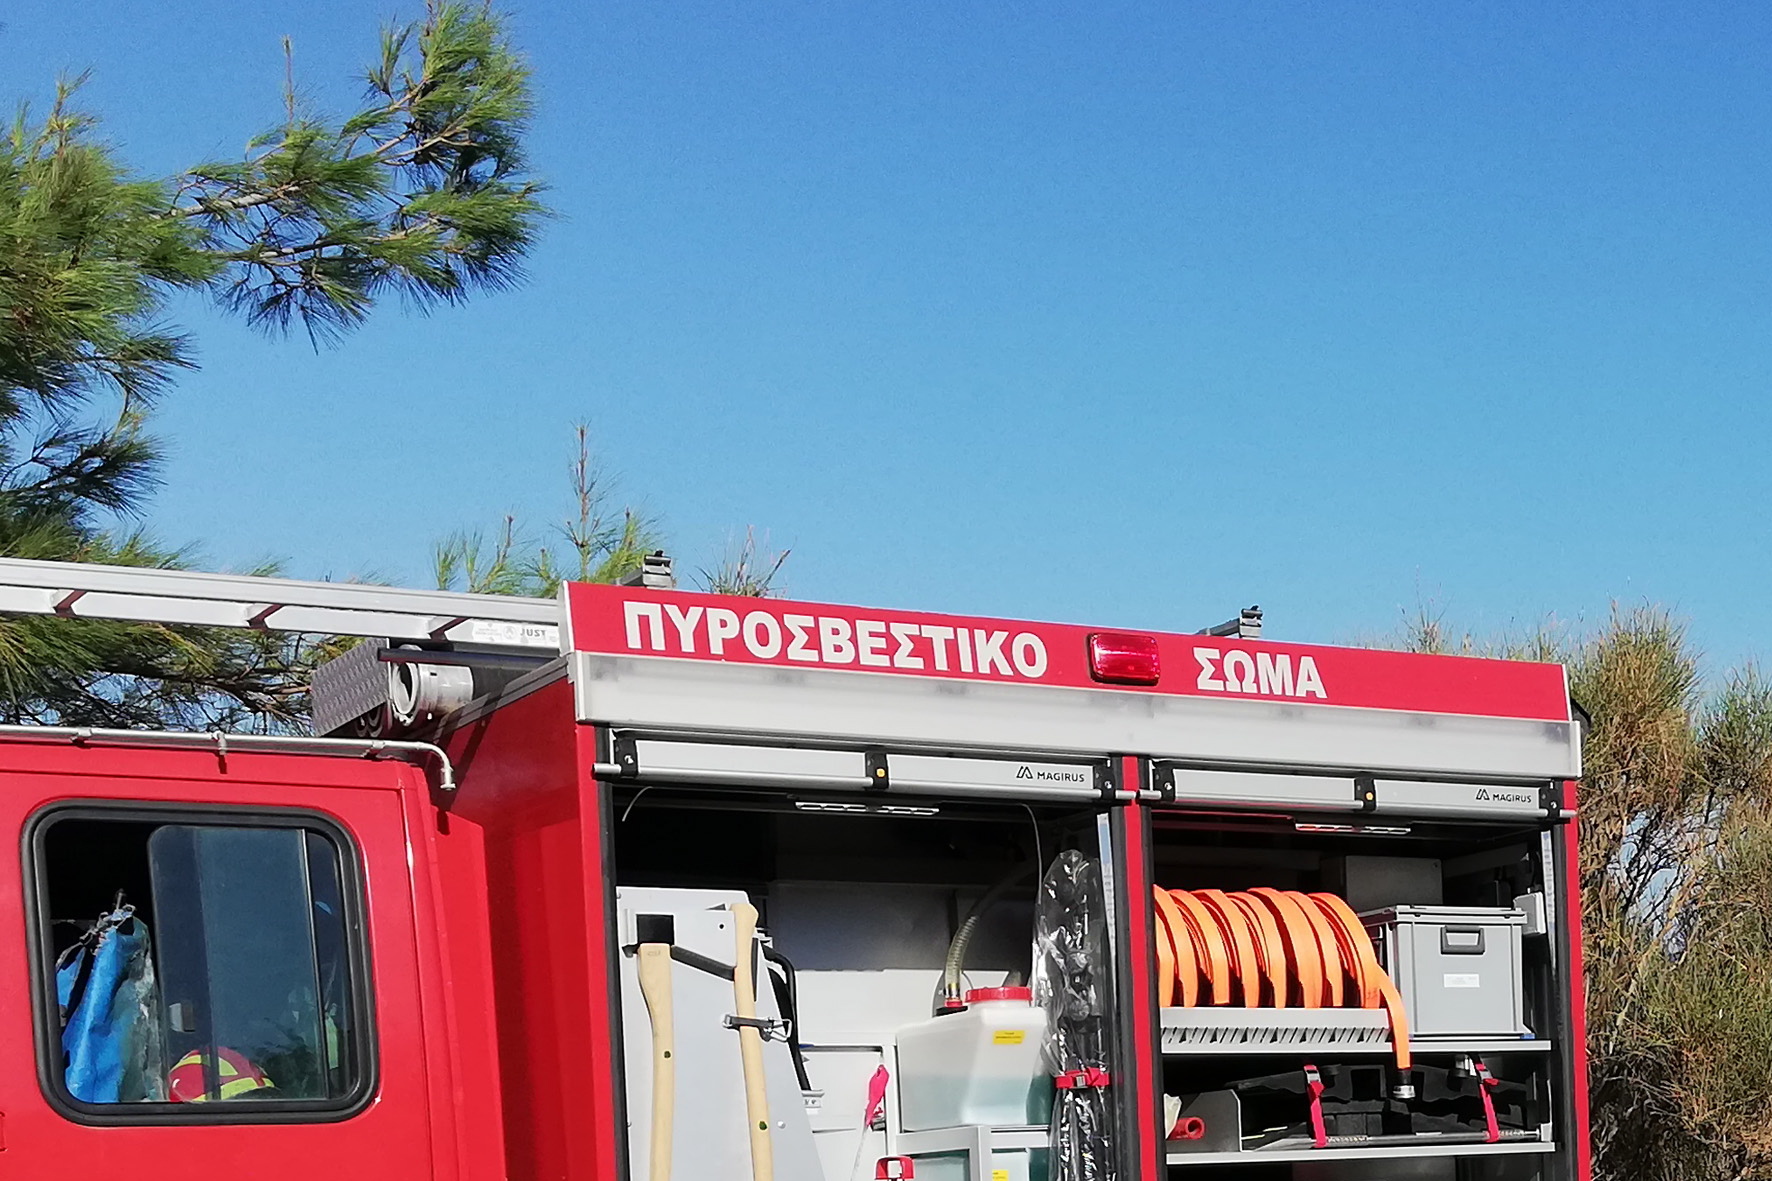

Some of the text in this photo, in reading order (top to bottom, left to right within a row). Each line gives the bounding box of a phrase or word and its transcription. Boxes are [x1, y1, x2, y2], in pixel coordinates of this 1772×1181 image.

[623, 600, 1327, 698] ΠΥΡΟΣΒΕΣΤΙΚΟ ΣΩΜΑ
[1037, 771, 1085, 783] MAGIRUS
[1492, 793, 1532, 804] MAGIRUS
